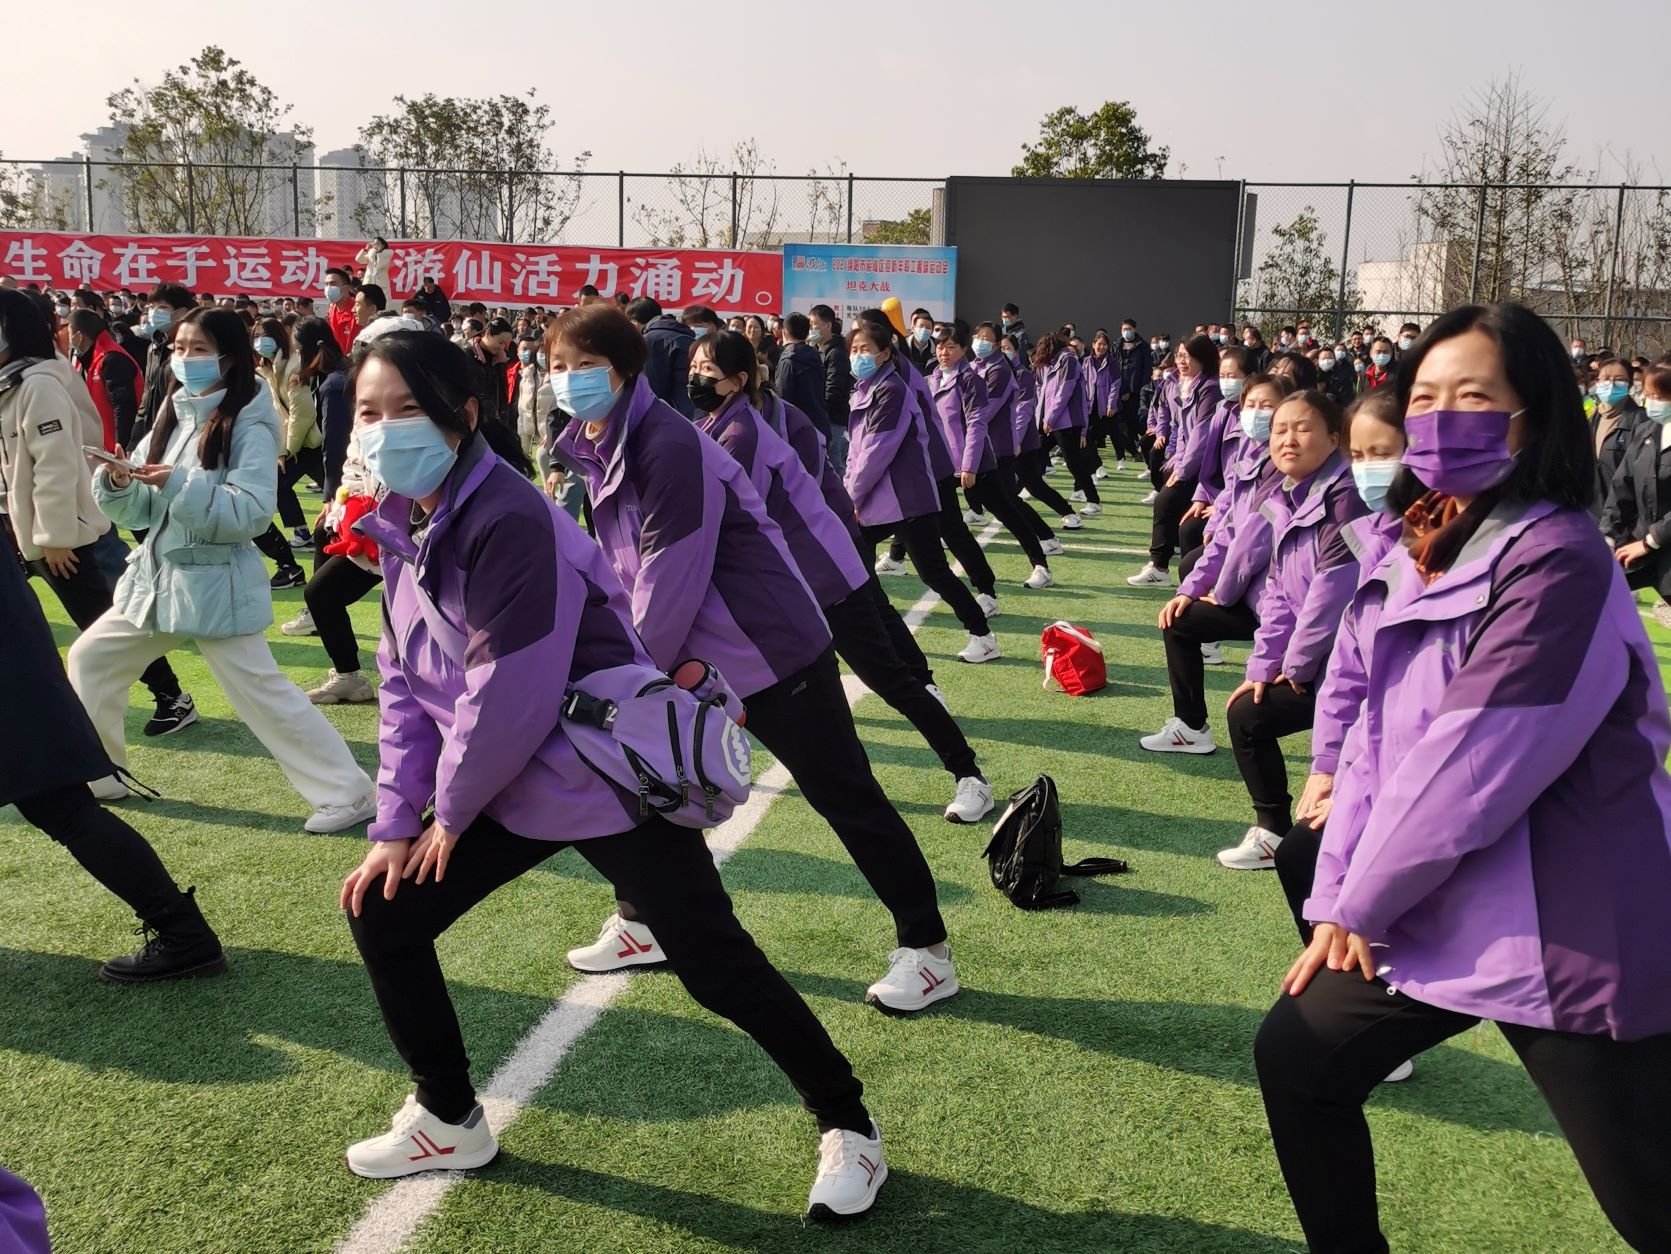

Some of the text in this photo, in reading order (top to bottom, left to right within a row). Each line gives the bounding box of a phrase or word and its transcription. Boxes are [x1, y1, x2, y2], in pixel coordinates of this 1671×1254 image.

[3, 238, 330, 291] 生命在于运动
[846, 280, 891, 292] 坦克大战
